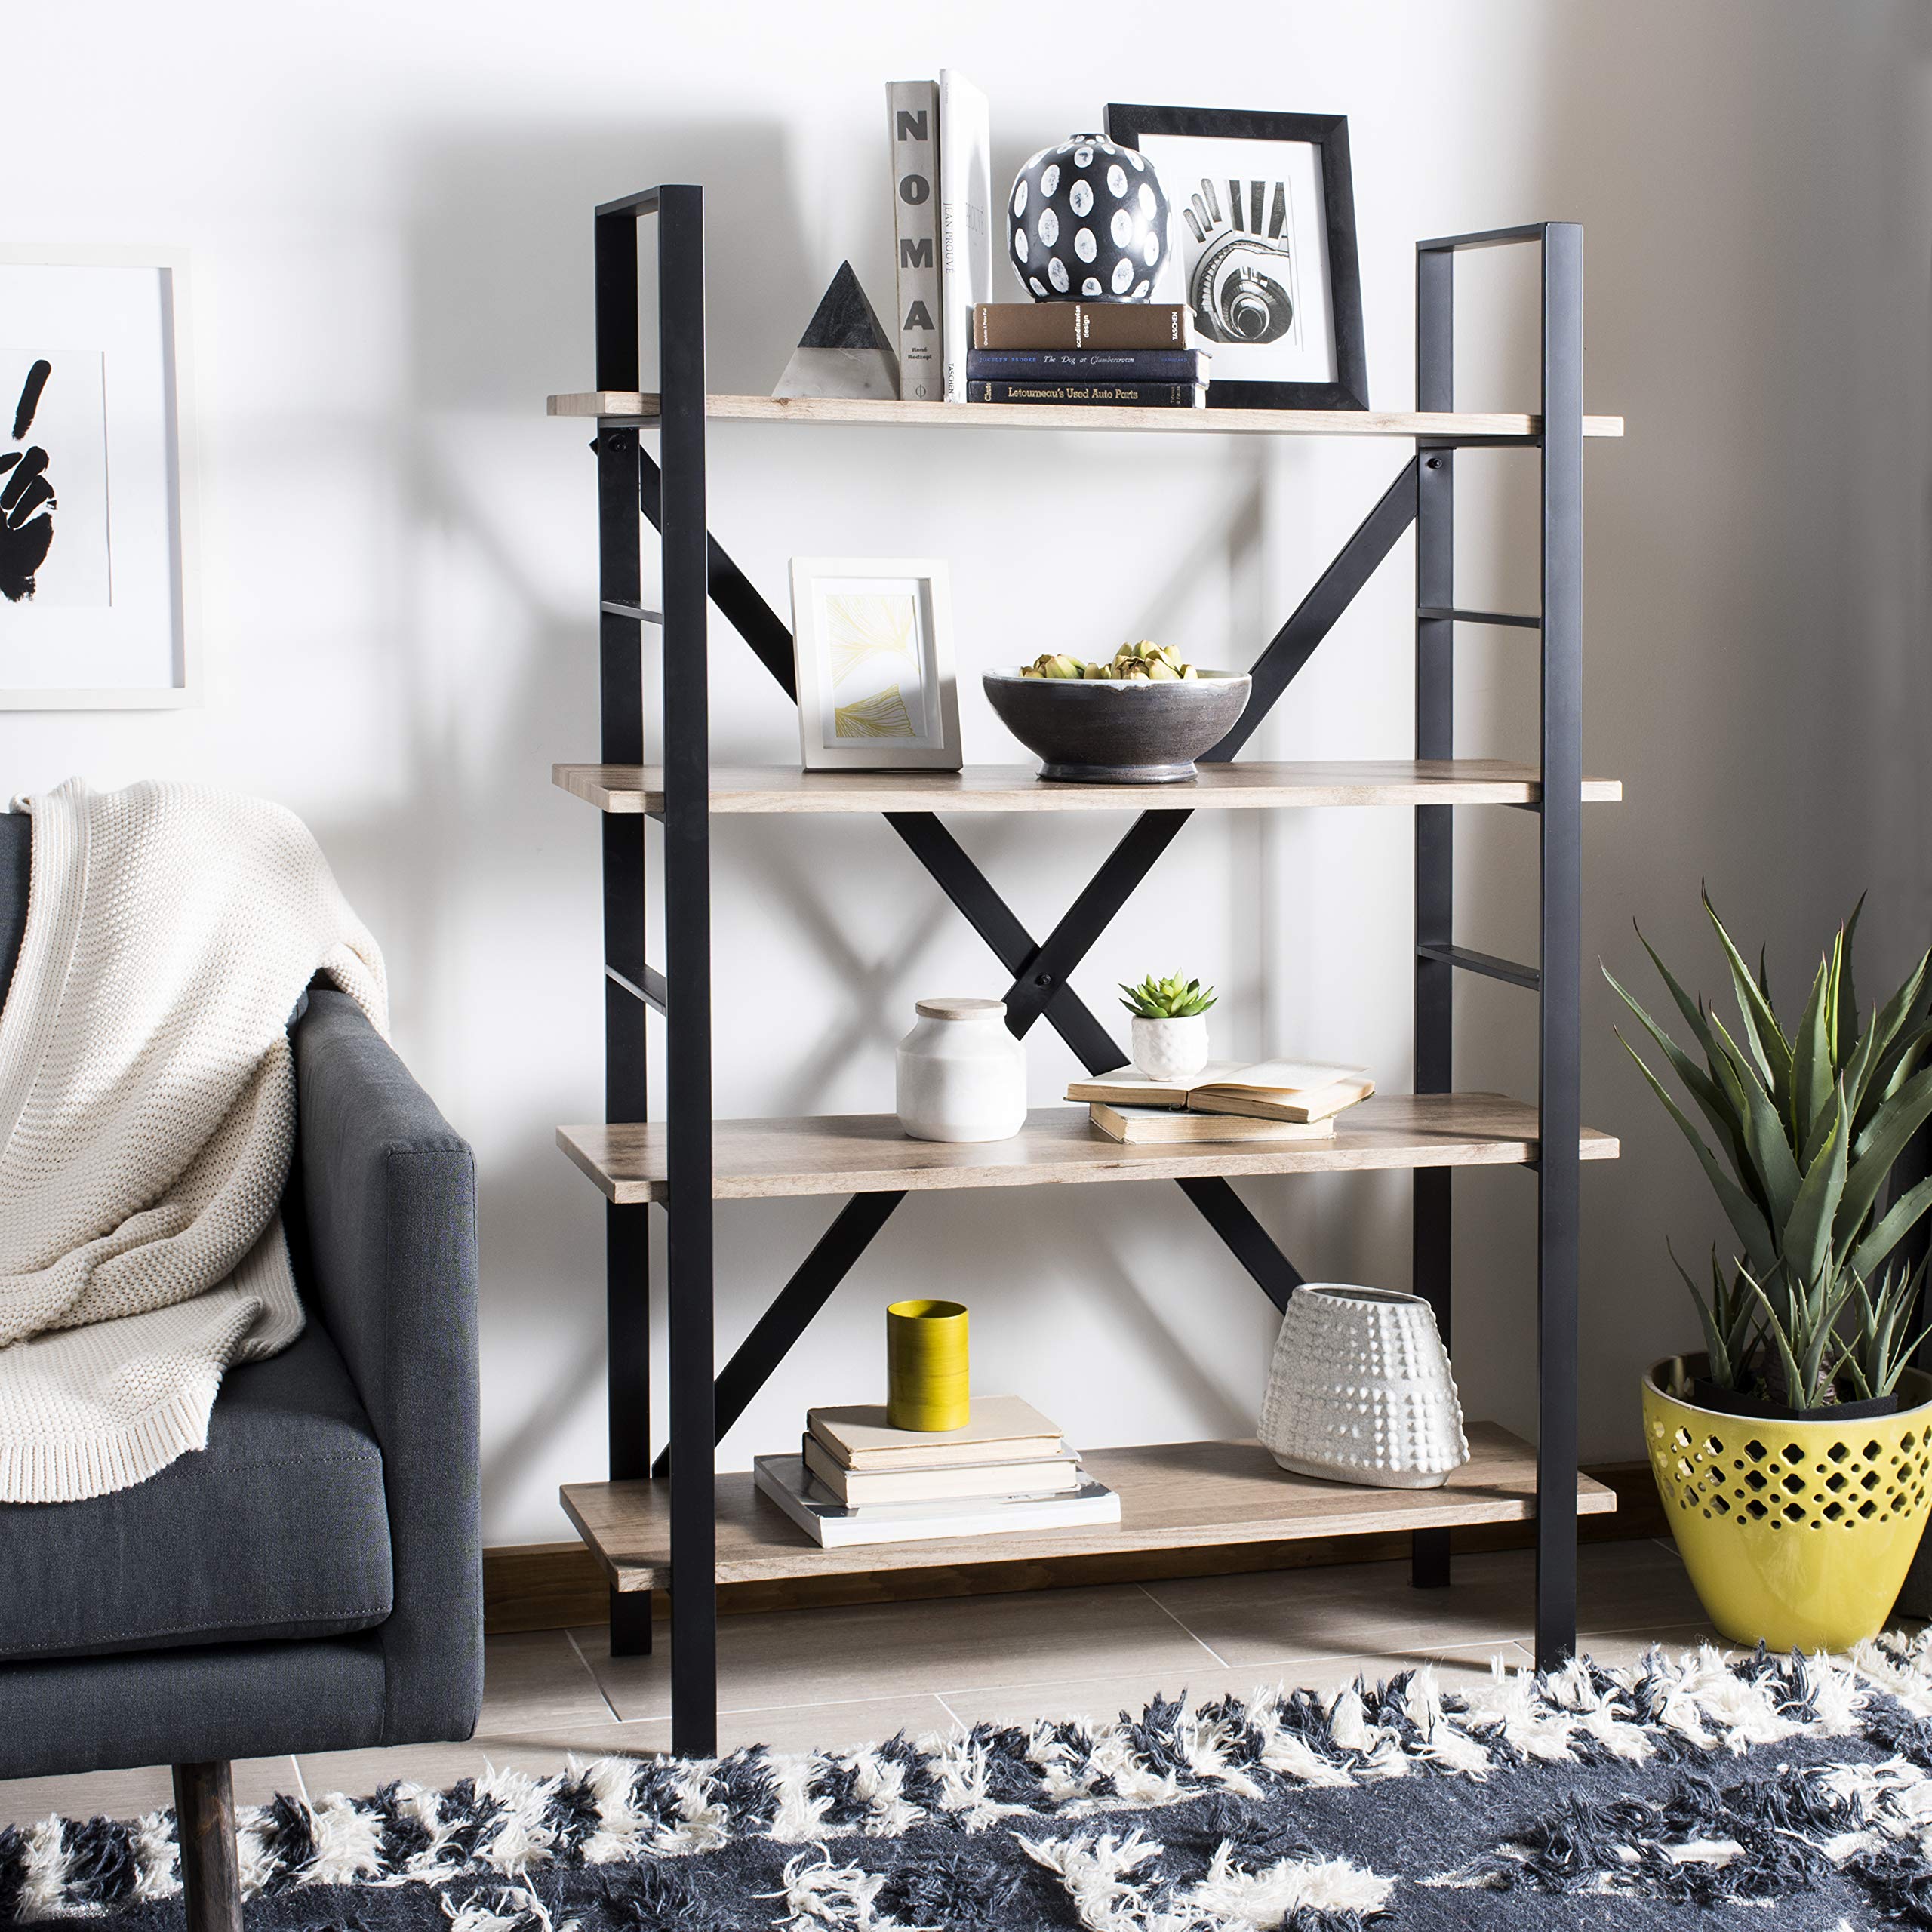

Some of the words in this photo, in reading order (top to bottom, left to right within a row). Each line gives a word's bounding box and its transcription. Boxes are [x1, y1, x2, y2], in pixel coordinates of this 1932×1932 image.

[897, 110, 935, 331] NOMA
[943, 202, 953, 227] JEAN
[1061, 355, 1076, 365] Dog
[1008, 386, 1064, 398] Letourneau's
[1066, 387, 1089, 398] Used
[1091, 389, 1113, 398] Auto
[1115, 389, 1138, 399] Parts
